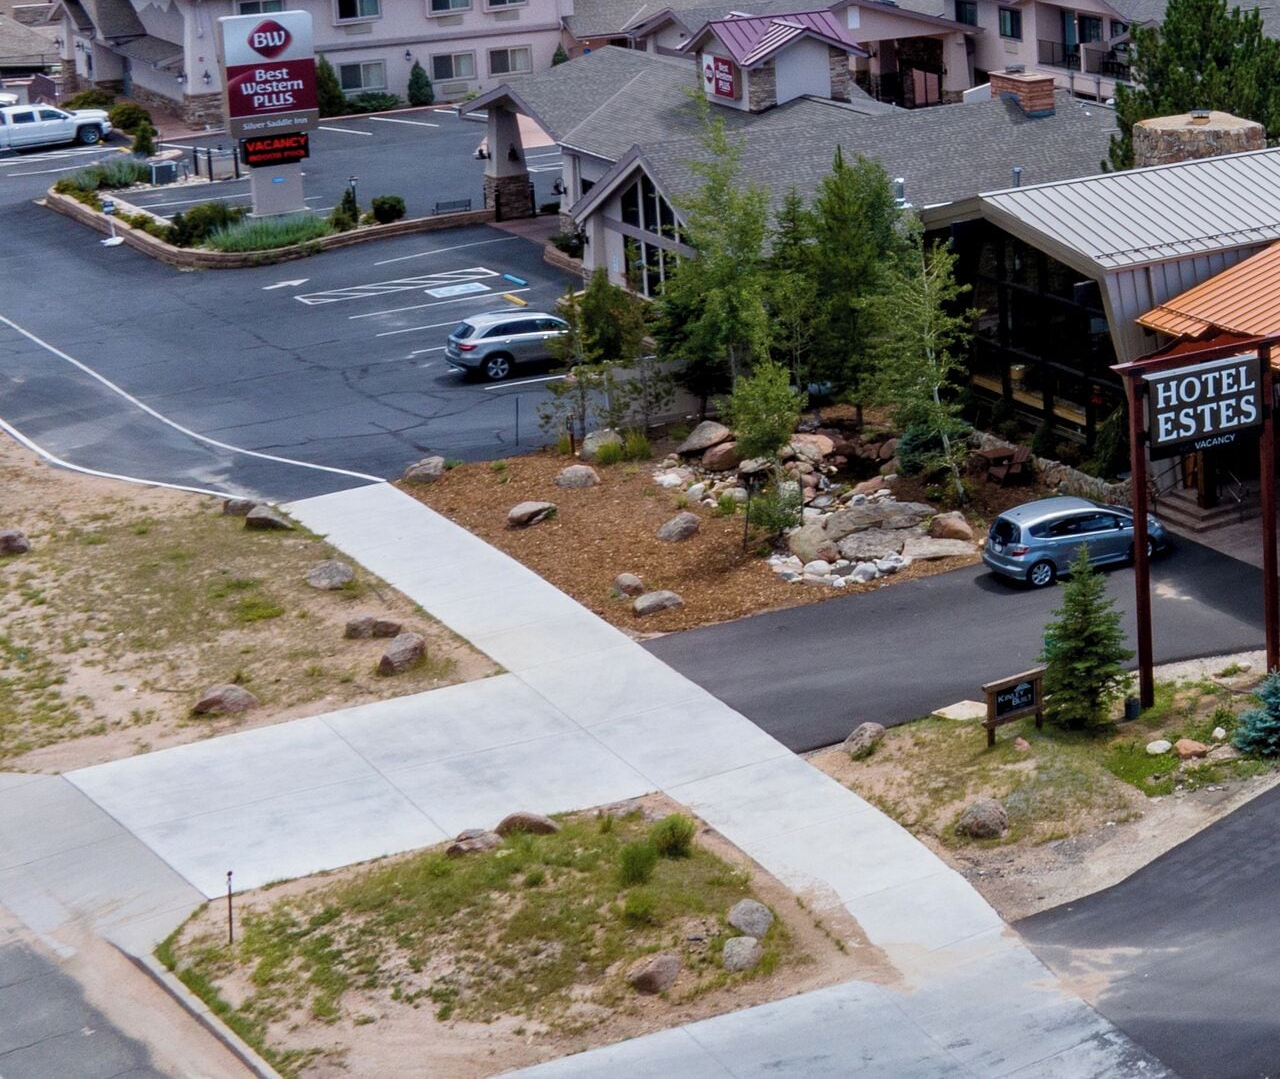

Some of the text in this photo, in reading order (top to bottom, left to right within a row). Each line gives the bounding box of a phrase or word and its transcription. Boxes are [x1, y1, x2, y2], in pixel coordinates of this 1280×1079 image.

[253, 30, 286, 48] BW
[255, 68, 289, 81] Best
[240, 80, 303, 95] Western
[253, 91, 294, 108] PLUS
[242, 122, 266, 131] Silver
[266, 118, 293, 128] Saddle
[246, 136, 306, 152] VACANCY
[1156, 365, 1256, 409] HOTEL
[1157, 394, 1257, 443] ESTES
[1194, 433, 1236, 450] VACANCY
